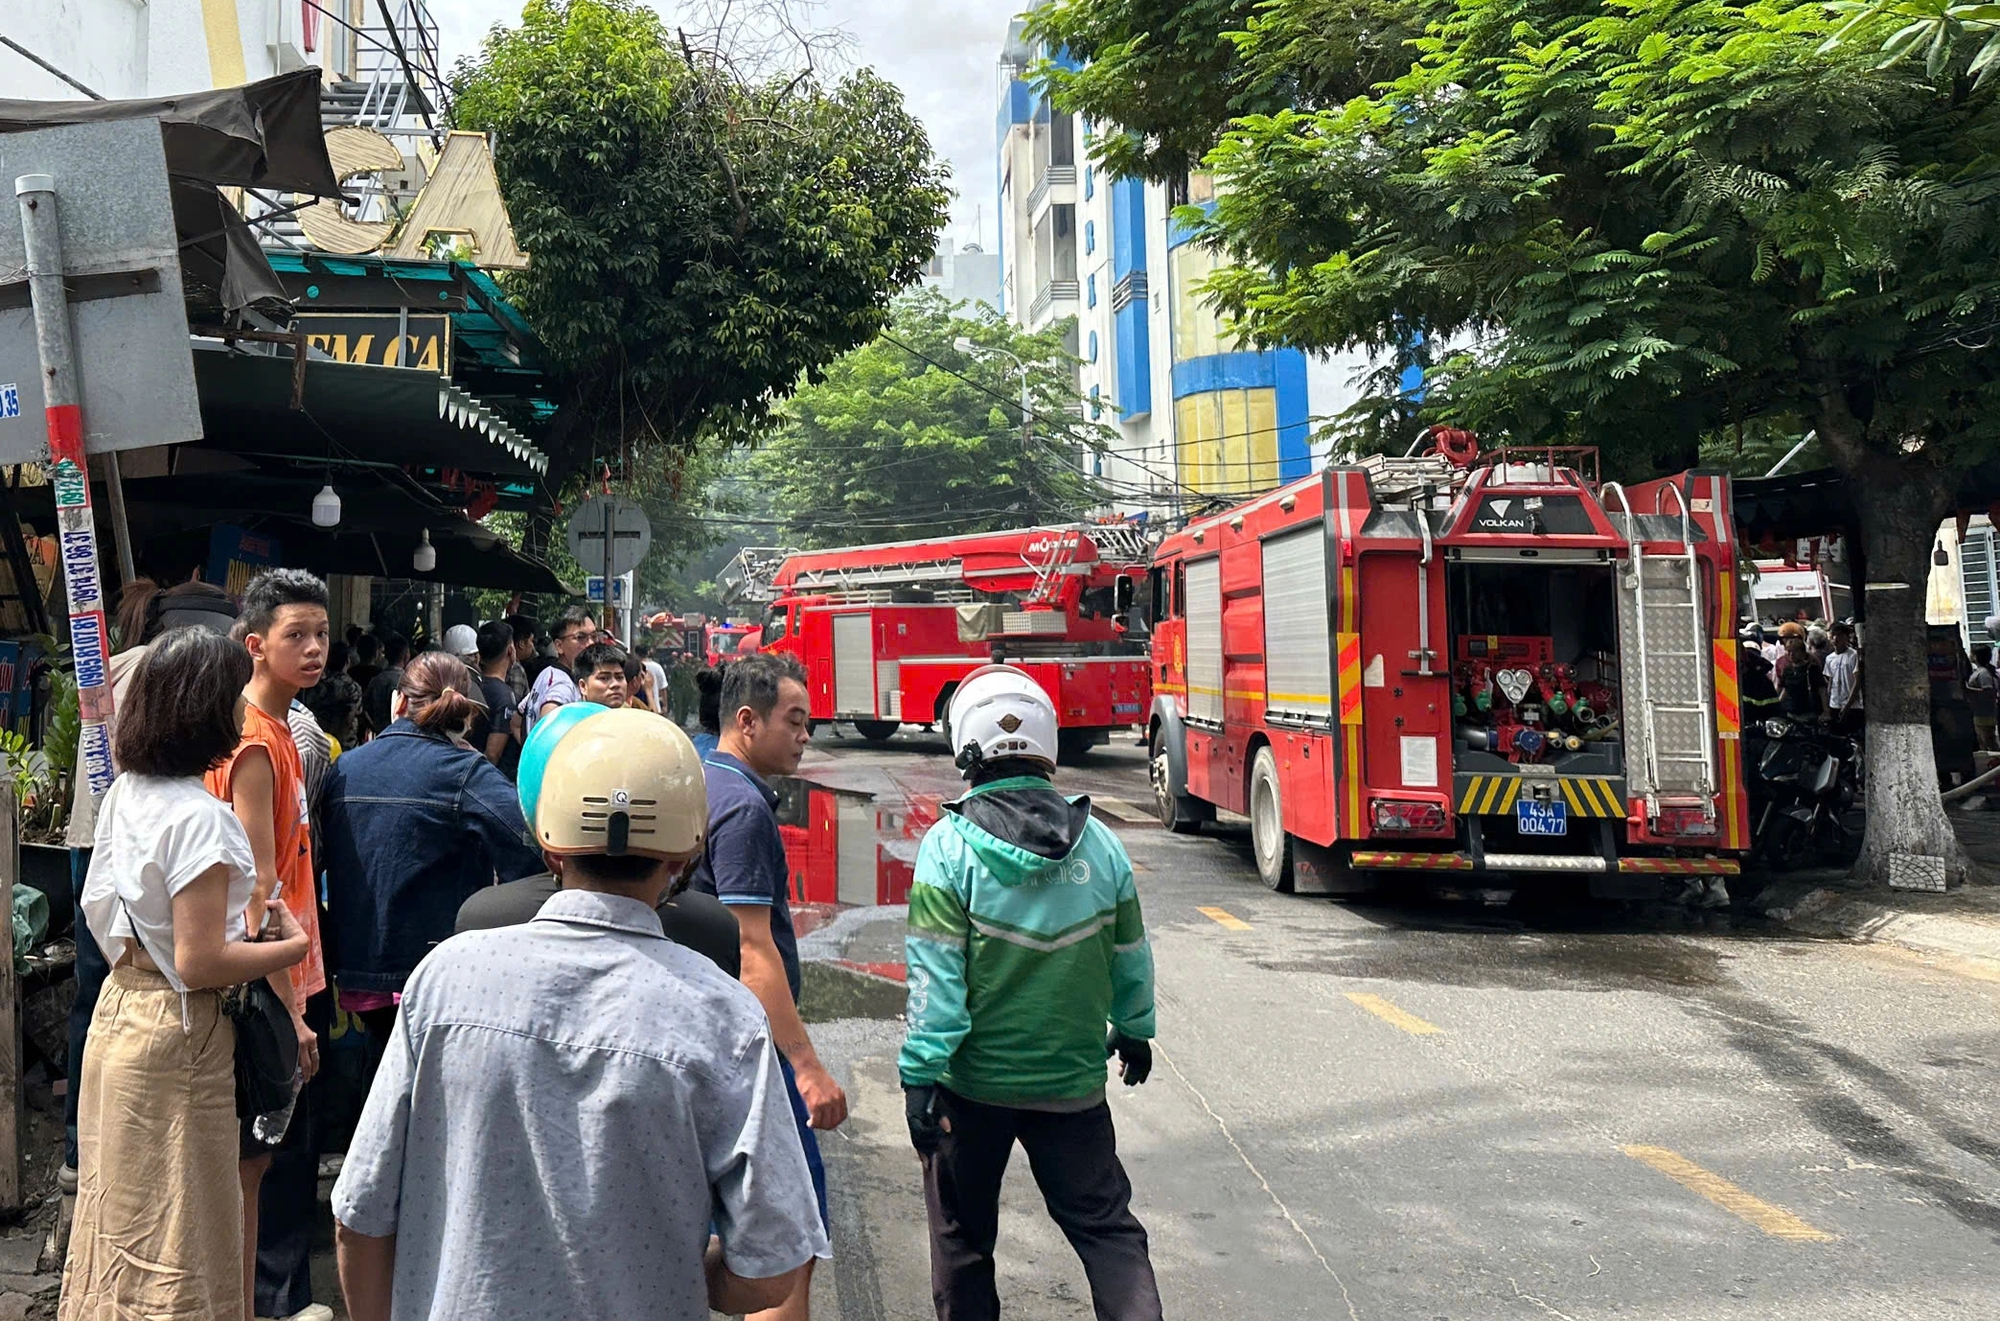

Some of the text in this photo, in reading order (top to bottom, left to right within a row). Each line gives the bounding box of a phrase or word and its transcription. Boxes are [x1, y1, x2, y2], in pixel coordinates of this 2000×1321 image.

[1479, 519, 1524, 527] VOLKAN
[1530, 802, 1554, 817] 43A
[1521, 817, 1564, 833] 004.77
